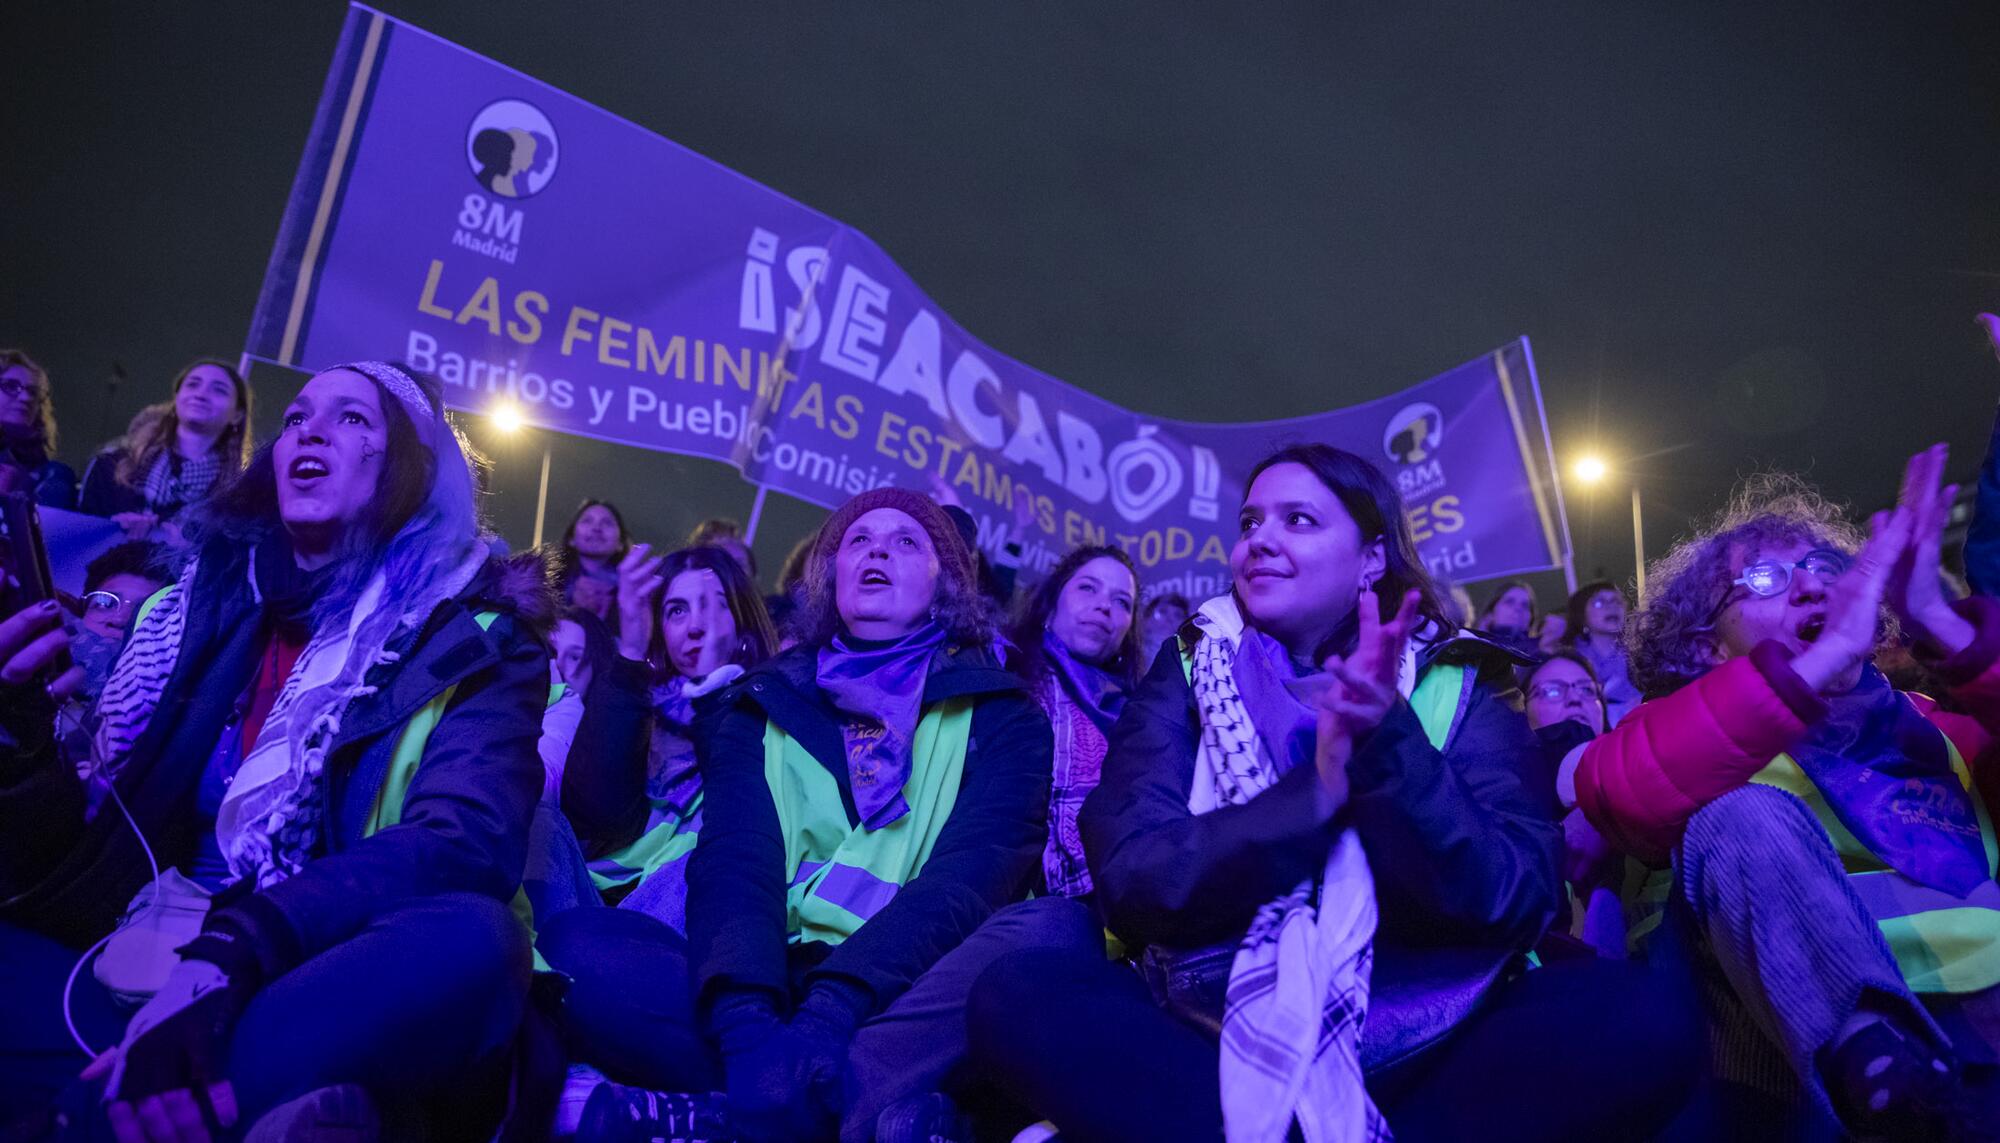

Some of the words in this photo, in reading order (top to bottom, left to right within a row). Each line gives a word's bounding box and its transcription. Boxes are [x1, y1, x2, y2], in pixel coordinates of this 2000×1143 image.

[458, 193, 525, 244] 8M
[452, 229, 518, 264] Madrid
[406, 330, 575, 409] Barrios
[588, 385, 614, 425] y
[627, 386, 752, 447] Puebl
[417, 259, 549, 344] LAS
[561, 305, 864, 439] FEMINITAS
[1064, 509, 1105, 548] EN
[1115, 526, 1229, 567] TODA
[1408, 495, 1465, 543] ES
[1397, 459, 1444, 491] 8M
